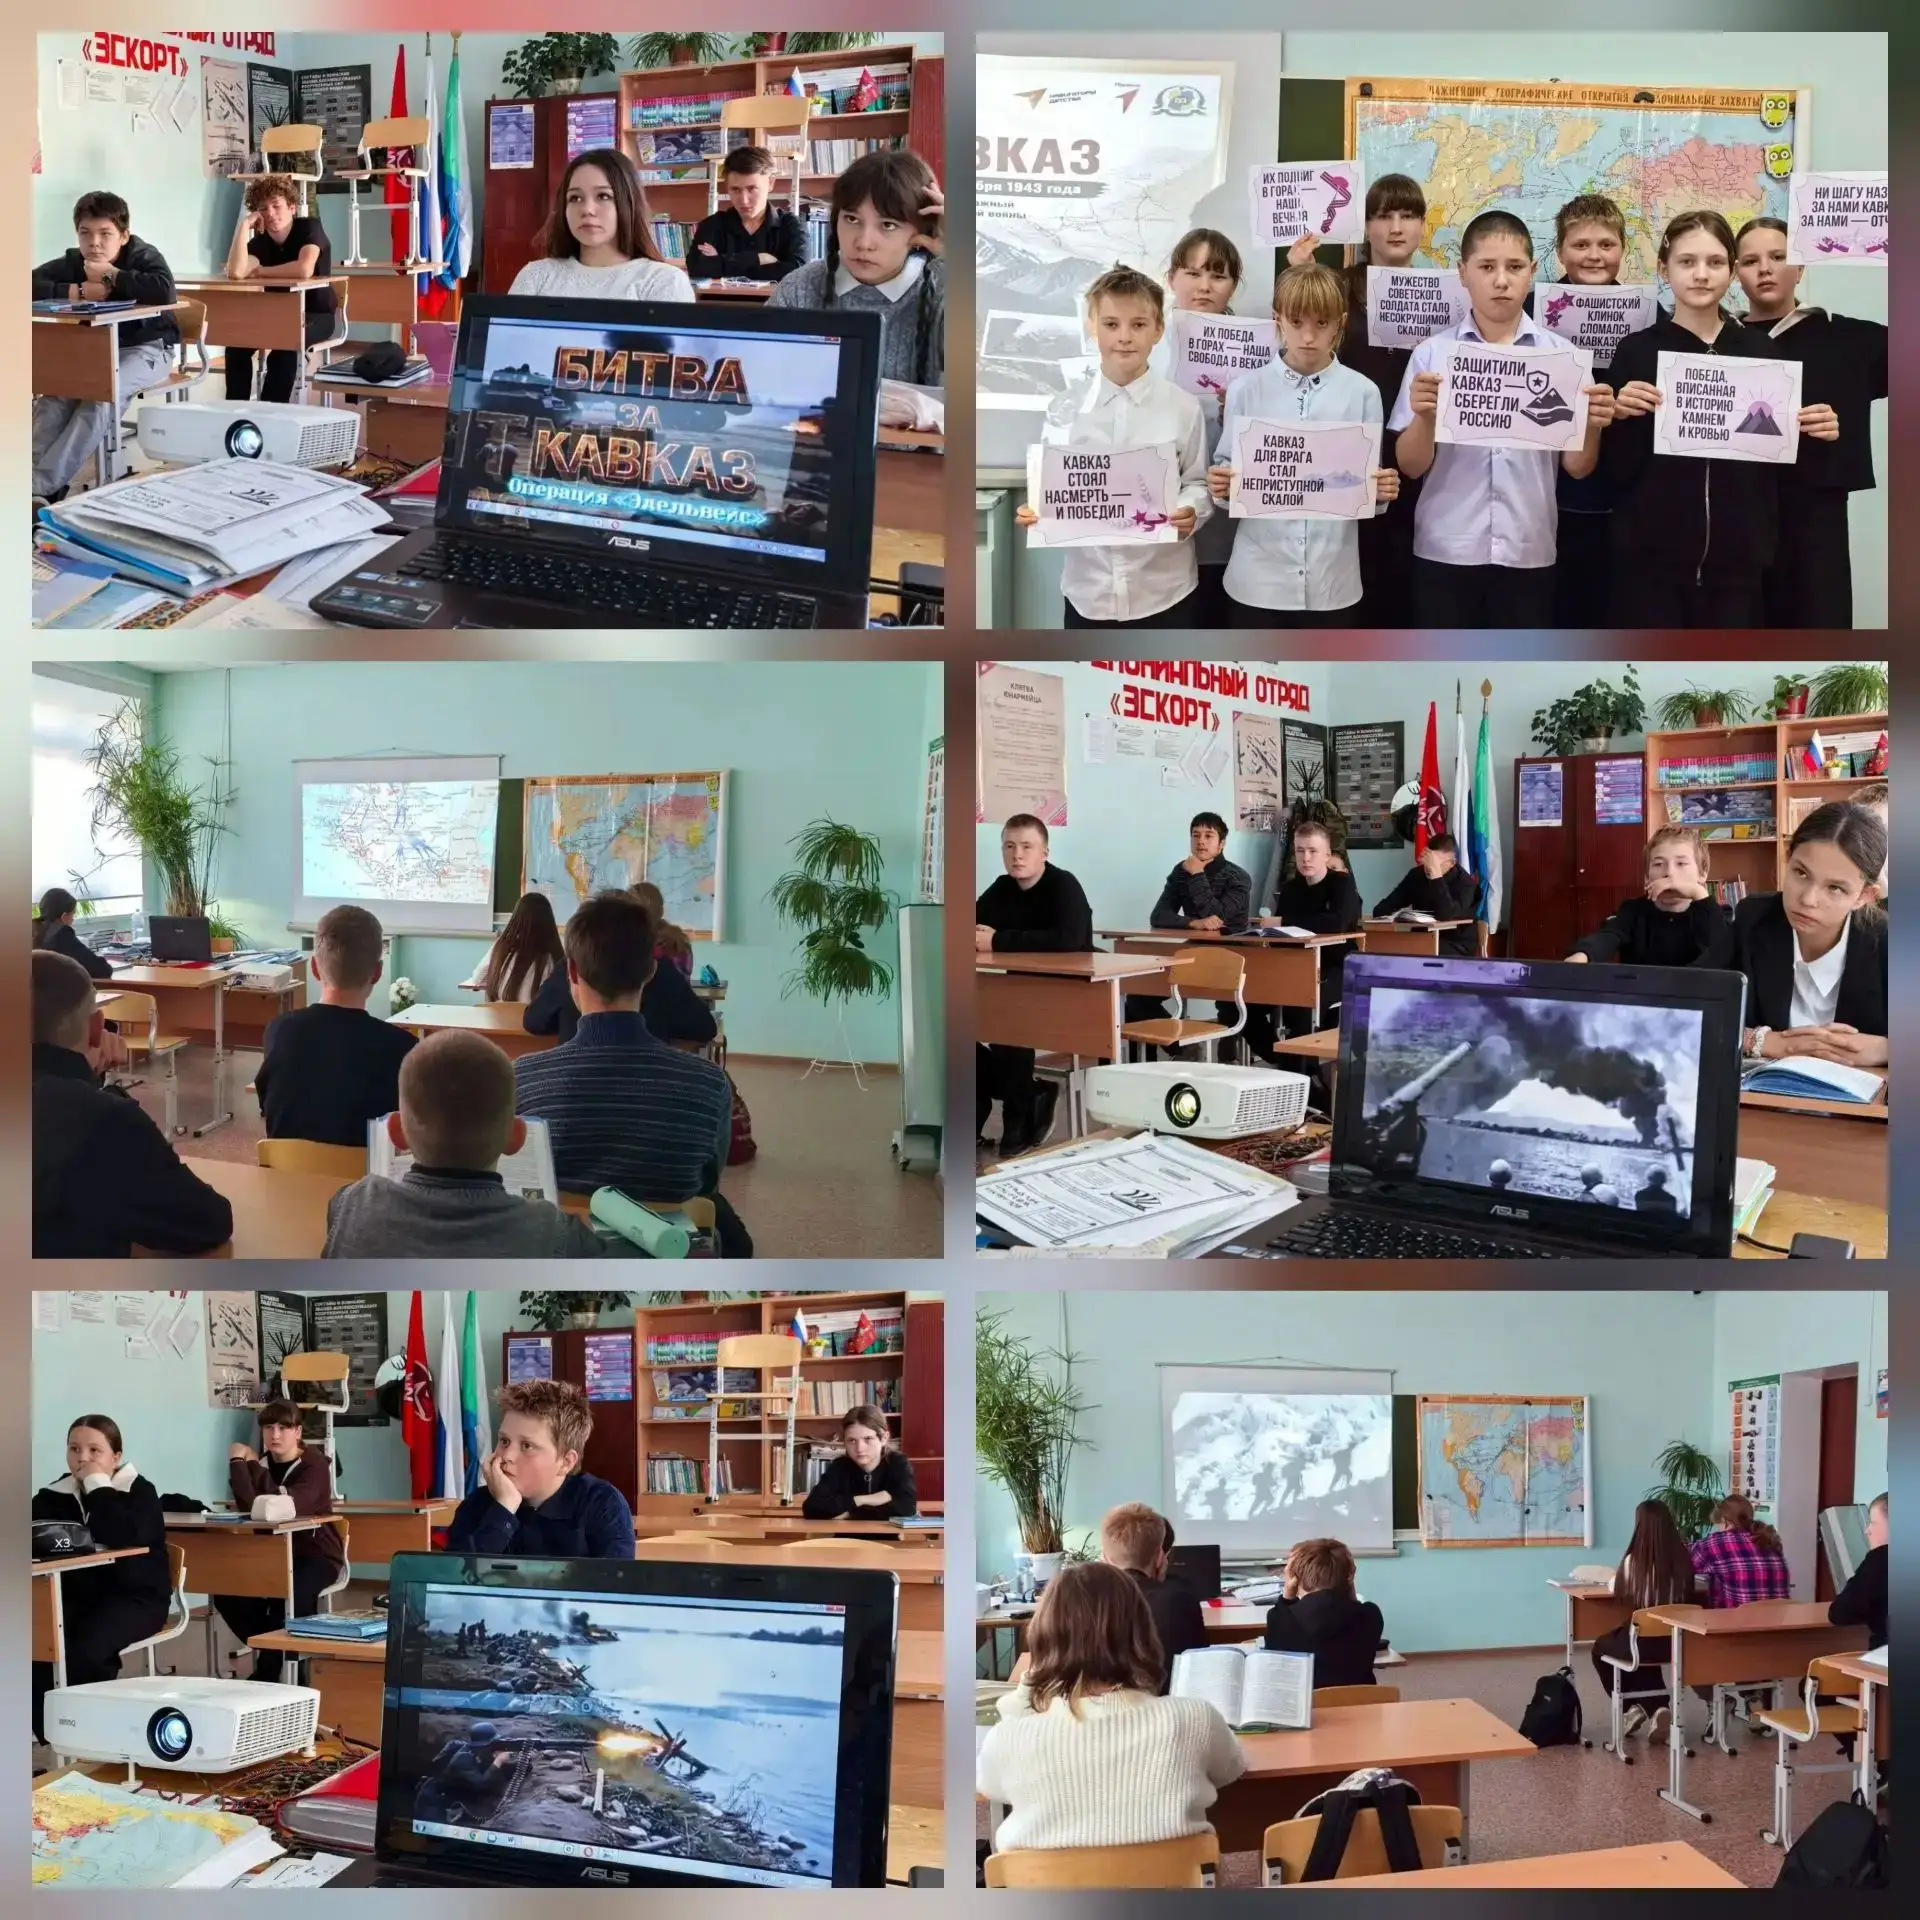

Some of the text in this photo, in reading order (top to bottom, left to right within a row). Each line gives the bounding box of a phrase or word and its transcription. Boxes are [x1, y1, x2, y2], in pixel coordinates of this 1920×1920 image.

[1581, 90, 1629, 103] ОТКРЫТИЯ
[1263, 173, 1276, 184] ИХ
[1007, 181, 1042, 194] 1943
[1047, 184, 1082, 196] года
[1262, 186, 1268, 198] В
[1814, 186, 1830, 199] НИ
[1832, 186, 1864, 199] ШАГУ
[1276, 198, 1304, 210] НАШ
[1812, 200, 1826, 213] ЗА
[1828, 200, 1860, 213] НАМИ
[1801, 215, 1814, 228] ЗА
[1816, 215, 1848, 228] НАМИ
[1391, 276, 1440, 288] МУЖЕСТВО
[1388, 288, 1442, 300] СОВЕТСКОГО
[1380, 300, 1450, 313] СОЛДАТА СТАЛО
[1576, 296, 1640, 309] ФАШИСТСКИЙ
[1380, 312, 1450, 326] НЕСОКРУШИМОЙ
[1588, 311, 1624, 322] КЛИНОК
[1204, 326, 1254, 343] ИХ ПОБЕДА
[1397, 324, 1431, 337] СКАЛОЙ
[1580, 324, 1630, 334] СЛОМАЛСЯ
[1188, 338, 1194, 349] В
[1196, 338, 1224, 352] ГОРАХ
[1243, 344, 1270, 358] НАША
[1188, 350, 1228, 368] СВОБОДА
[1231, 356, 1237, 368] В
[1454, 356, 1526, 377] ЗАЩИТИЛИ
[556, 346, 752, 404] БИТВА
[1685, 368, 1728, 384] ПОБЕДА,
[1452, 375, 1502, 392] КАВКАЗ
[1676, 382, 1736, 398] ВПИСАННАЯ
[1454, 392, 1520, 412] СБЕРЕГЛИ
[1676, 396, 1734, 412] В ИСТОРИЮ
[616, 403, 664, 434] ЗА
[1459, 411, 1512, 429] РОССИЮ
[1682, 412, 1726, 426] КАМНЕМ
[1678, 426, 1730, 440] И КРОВЬЮ
[1263, 434, 1305, 449] КАВКАЗ
[533, 430, 758, 496] КАВКАЗ
[1063, 455, 1110, 470] КАВКАЗ
[1254, 449, 1312, 464] ДЛЯ ВРАГА
[1068, 472, 1106, 486] СТОЯЛ
[1269, 465, 1296, 478] СТАЛ
[508, 477, 608, 506] Операция
[1242, 478, 1324, 492] НЕПРИСТУПНОЙ
[1045, 489, 1108, 504] НАСМЕРТЬ
[1262, 492, 1304, 506] СКАЛОЙ
[1056, 504, 1124, 520] И ПОБЕДИЛ
[608, 536, 650, 550] ASUS
[1256, 674, 1310, 712] ОТРЯД
[1110, 684, 1220, 732] «ЭСКОРТ»
[1490, 1204, 1530, 1220] ASUS
[580, 1866, 630, 1884] ASUS
